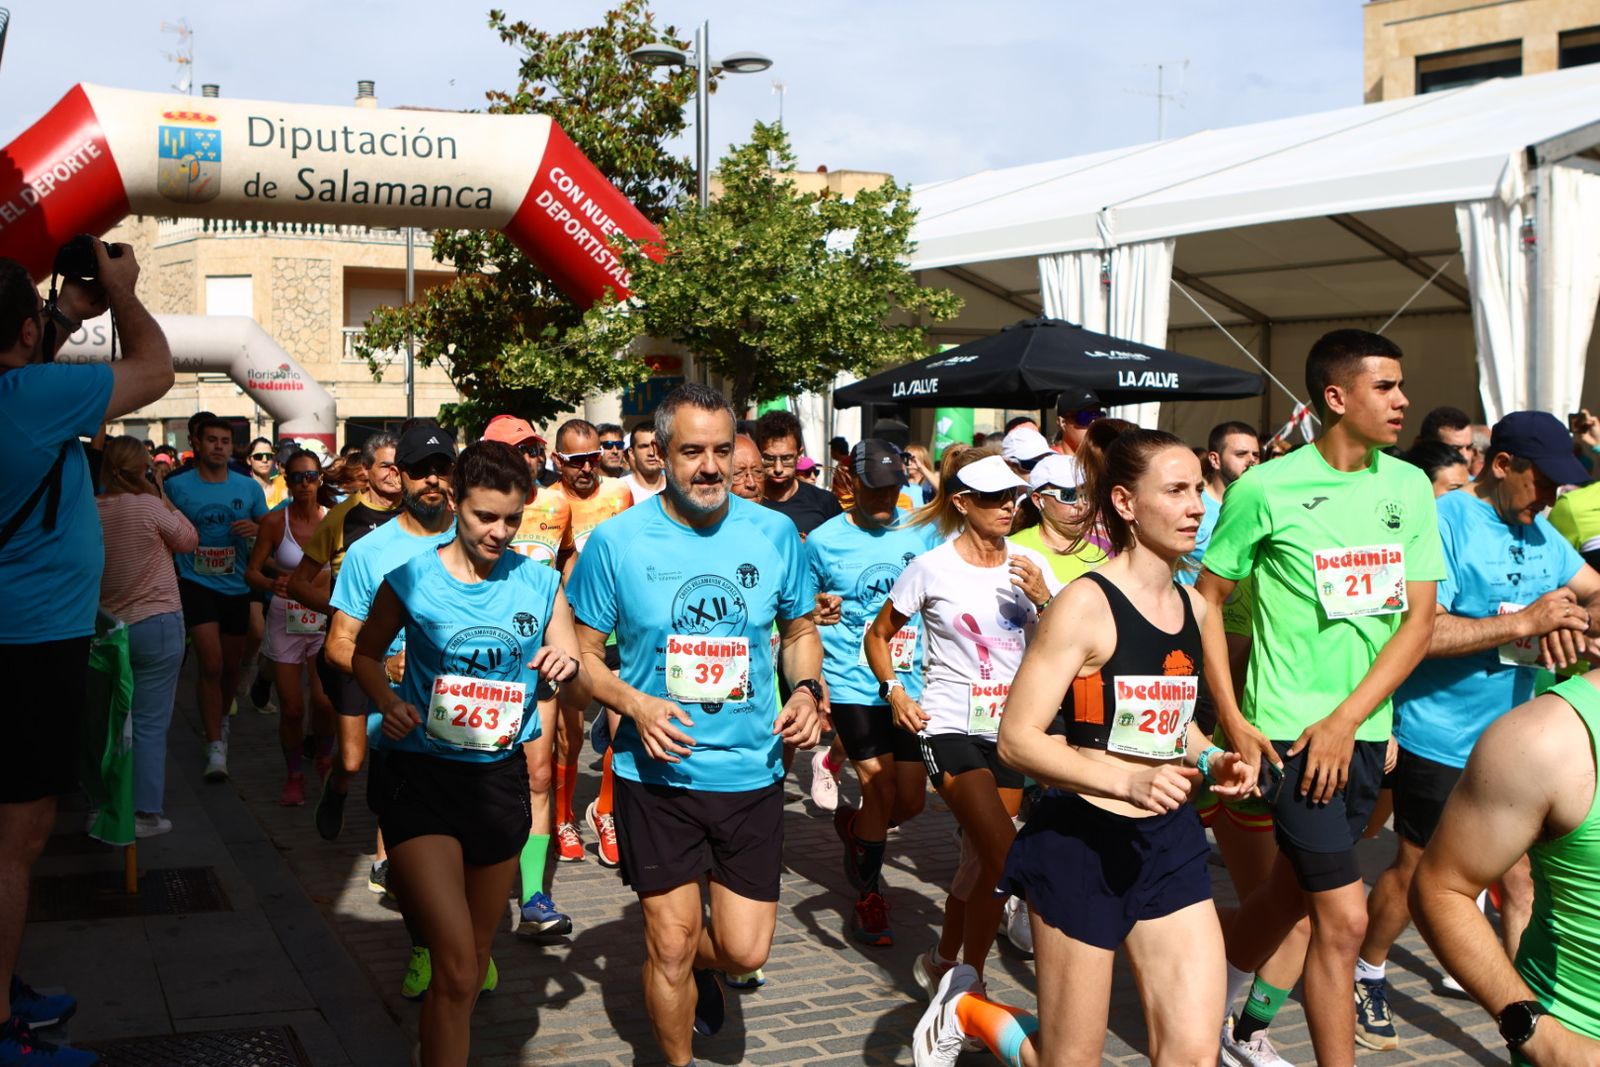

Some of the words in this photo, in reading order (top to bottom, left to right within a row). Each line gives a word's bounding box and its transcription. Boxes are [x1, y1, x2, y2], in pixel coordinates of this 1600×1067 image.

[248, 116, 457, 159] Diputación
[0, 201, 26, 223] EL
[20, 139, 102, 207] DEPORTE
[243, 172, 278, 199] de
[295, 167, 493, 210] Salamanca
[549, 166, 585, 204] CON
[580, 198, 649, 260] NUES
[535, 190, 632, 288] DEPORTISTAS
[247, 379, 304, 391] bedunia
[892, 381, 906, 397] LA
[907, 378, 939, 395] SALVE
[1118, 370, 1137, 387] LA
[1137, 371, 1179, 388] SALVE
[1315, 548, 1402, 571] bedunia
[1345, 573, 1372, 597] 21
[301, 612, 317, 624] 63
[687, 597, 727, 625] XII
[464, 628, 497, 638] VILLAMAYOR
[668, 638, 747, 658] bedunia
[459, 648, 501, 675] XII
[695, 663, 724, 685] 39
[435, 678, 524, 704] bedunia
[1118, 681, 1195, 701] bedunia
[452, 704, 500, 730] 263
[1138, 709, 1181, 735] 280
